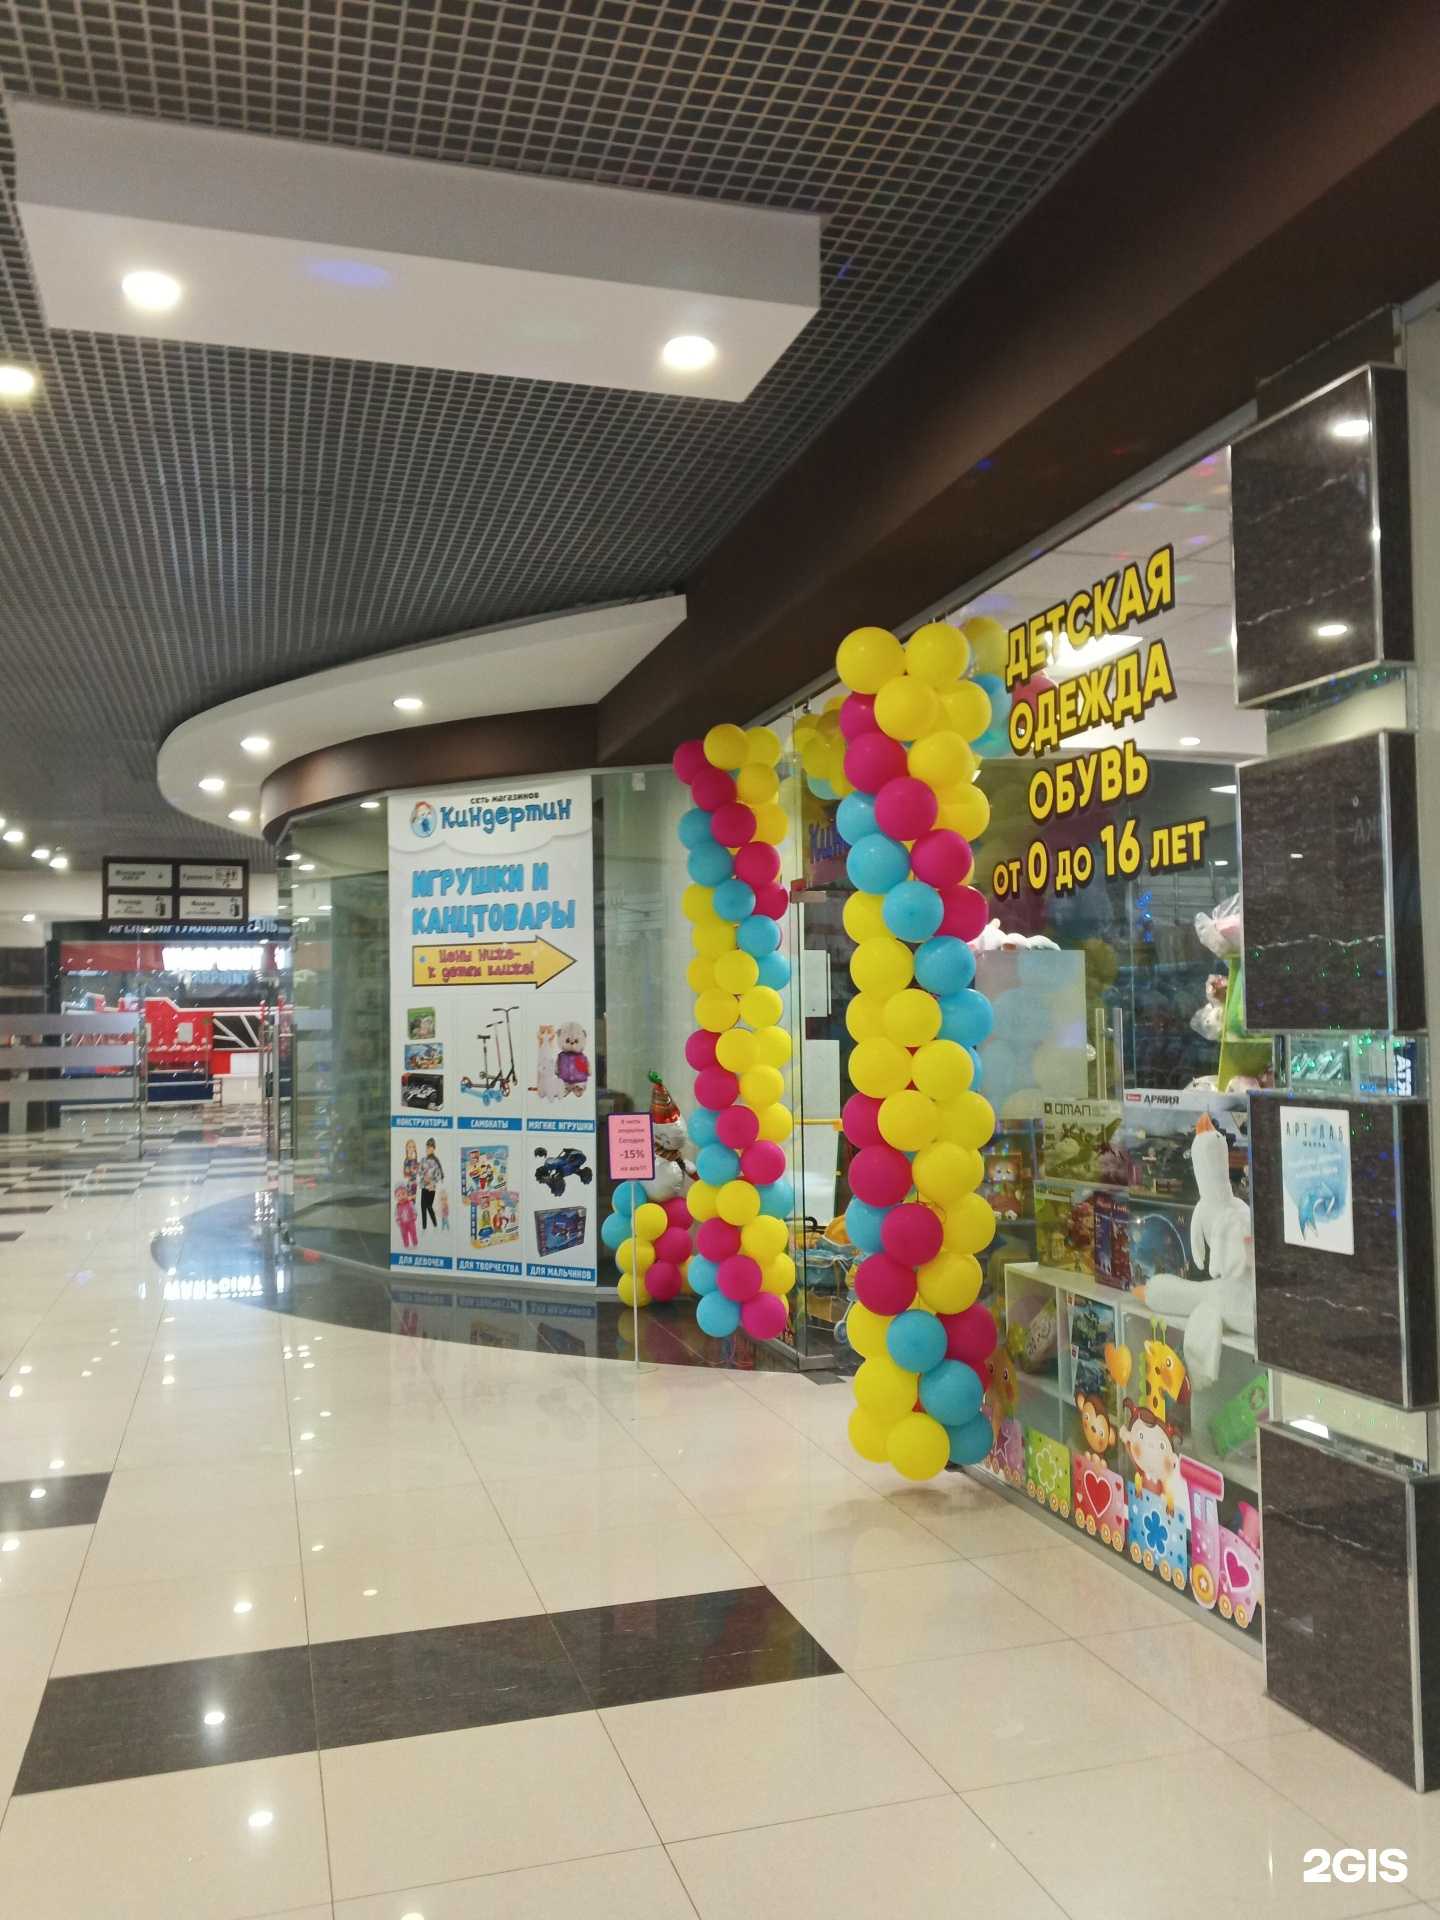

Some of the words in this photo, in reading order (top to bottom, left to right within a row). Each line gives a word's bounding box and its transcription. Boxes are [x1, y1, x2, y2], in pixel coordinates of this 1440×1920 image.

[1005, 543, 1175, 692] ДЕТСКАЯ
[1009, 638, 1176, 757] ОДЕЖДА
[1028, 739, 1149, 823] ОБУВЬ
[440, 798, 572, 834] Киндертин
[1027, 841, 1049, 894] 0
[1100, 818, 1142, 880] 16
[1149, 820, 1207, 873] ЛЕТ
[411, 863, 524, 898] ИГРУШКИ
[532, 862, 549, 891] И
[412, 900, 576, 937] КАНЦТОВАРЫ
[1143, 1095, 1180, 1105] АРМИЯ
[396, 1117, 448, 1128] КОНСТРУКТОРЫ
[470, 1119, 509, 1129] САМОКАТЫ
[528, 1120, 557, 1130] МЯГКИЕ
[620, 1150, 645, 1159] -15%
[398, 1255, 412, 1265] ДЛЯ
[459, 1259, 473, 1269] ДЛЯ
[476, 1261, 520, 1273] ТВОРЧЕСТВА
[530, 1266, 546, 1276] ДЛЯ
[547, 1268, 592, 1279] МАЛЬЧИКОВ
